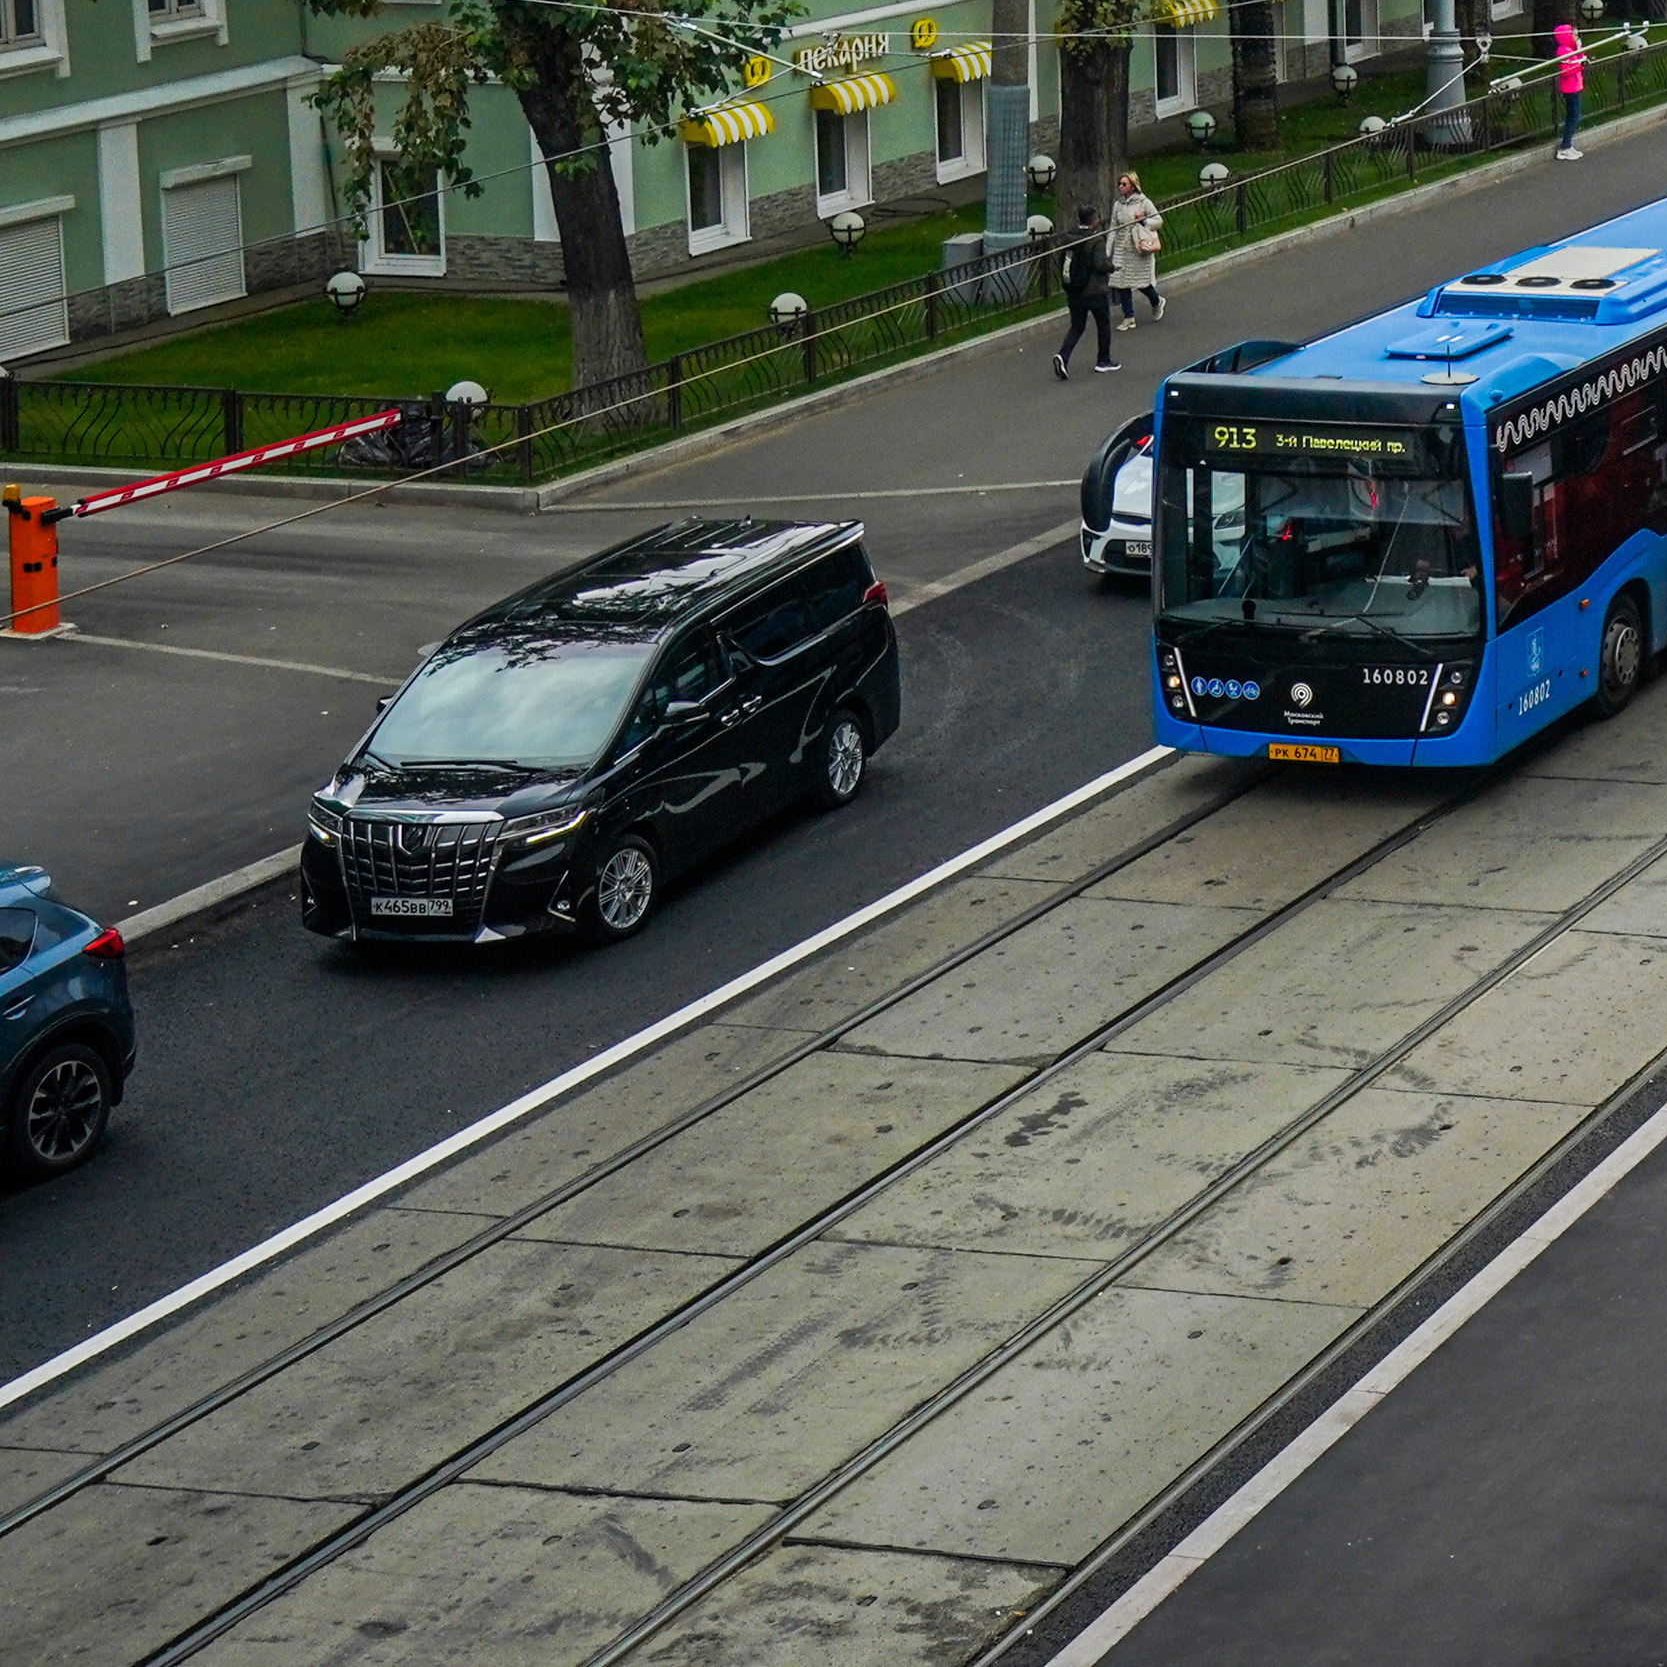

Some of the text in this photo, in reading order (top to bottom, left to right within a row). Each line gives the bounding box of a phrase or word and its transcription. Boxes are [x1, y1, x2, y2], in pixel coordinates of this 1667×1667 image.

[800, 34, 889, 72] пекарня
[1214, 426, 1406, 454] 913 3-й Павелецкий пр.
[1362, 668, 1429, 685] 160802
[1518, 679, 1551, 716] 160802
[1294, 747, 1317, 760] 674
[429, 900, 449, 911] 799
